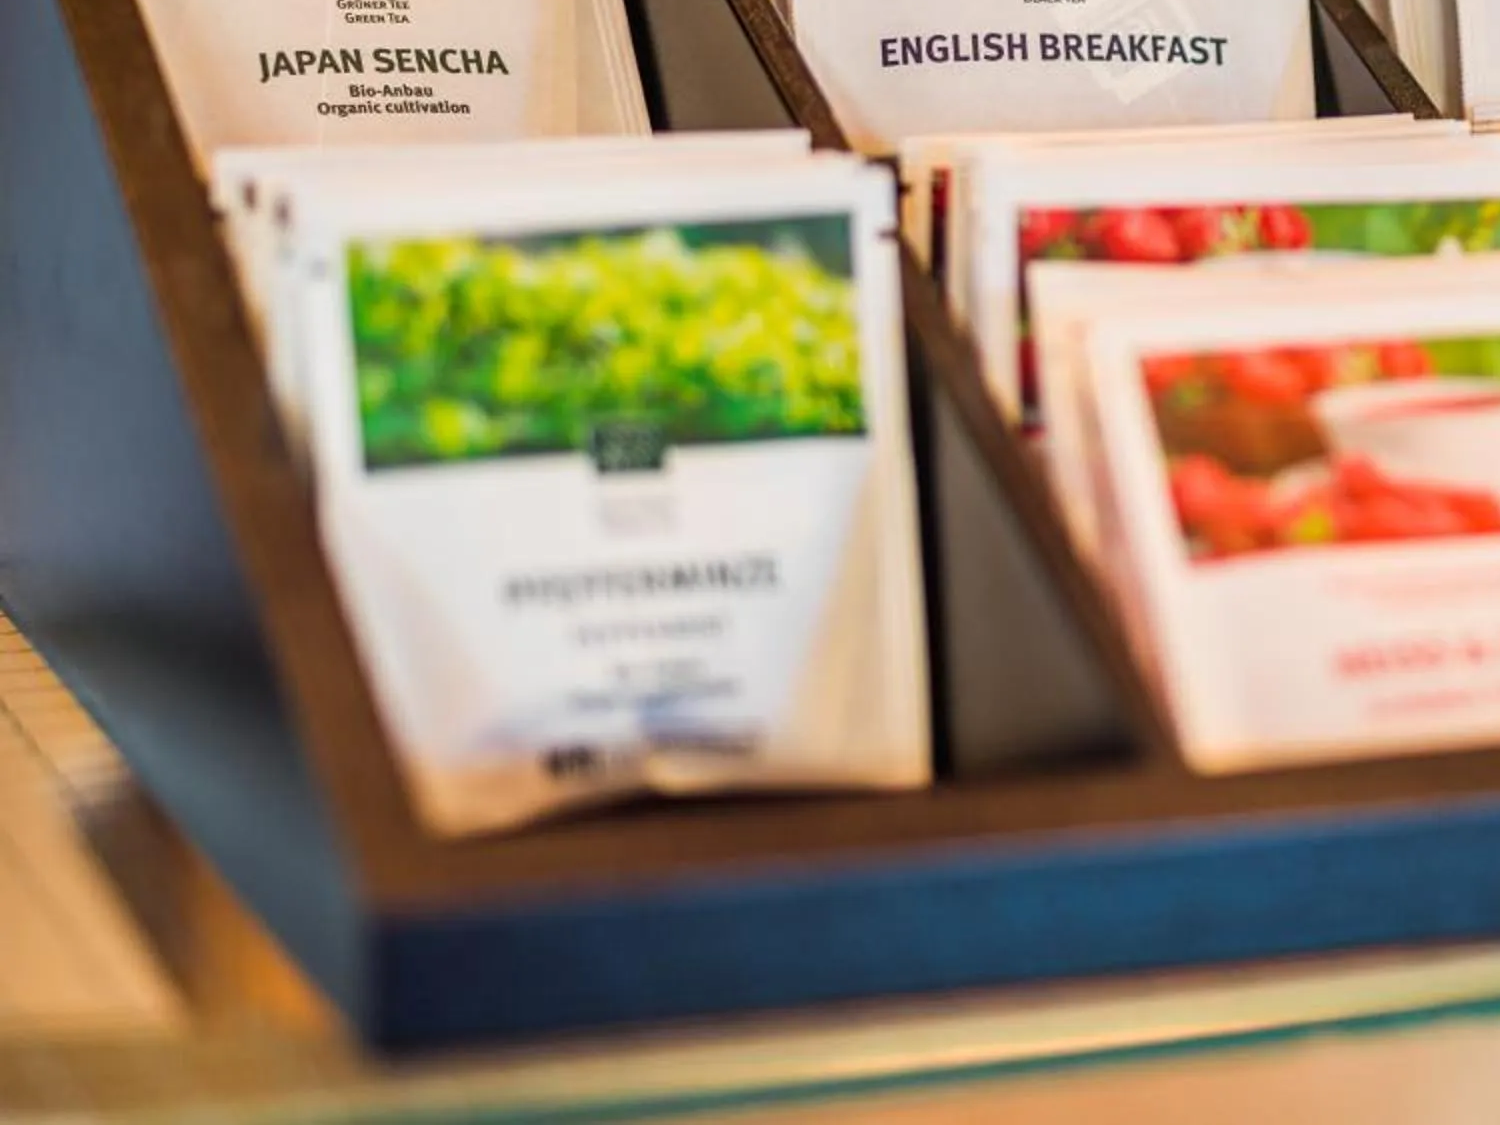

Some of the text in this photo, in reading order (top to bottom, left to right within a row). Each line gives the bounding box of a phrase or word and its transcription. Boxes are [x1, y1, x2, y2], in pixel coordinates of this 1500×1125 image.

[880, 32, 1228, 68] ENGLISH BREAKFAST
[258, 48, 510, 84] JAPAN SENCHA
[348, 83, 434, 98] Bio-Anbau
[316, 100, 471, 118] Organic cultivation
